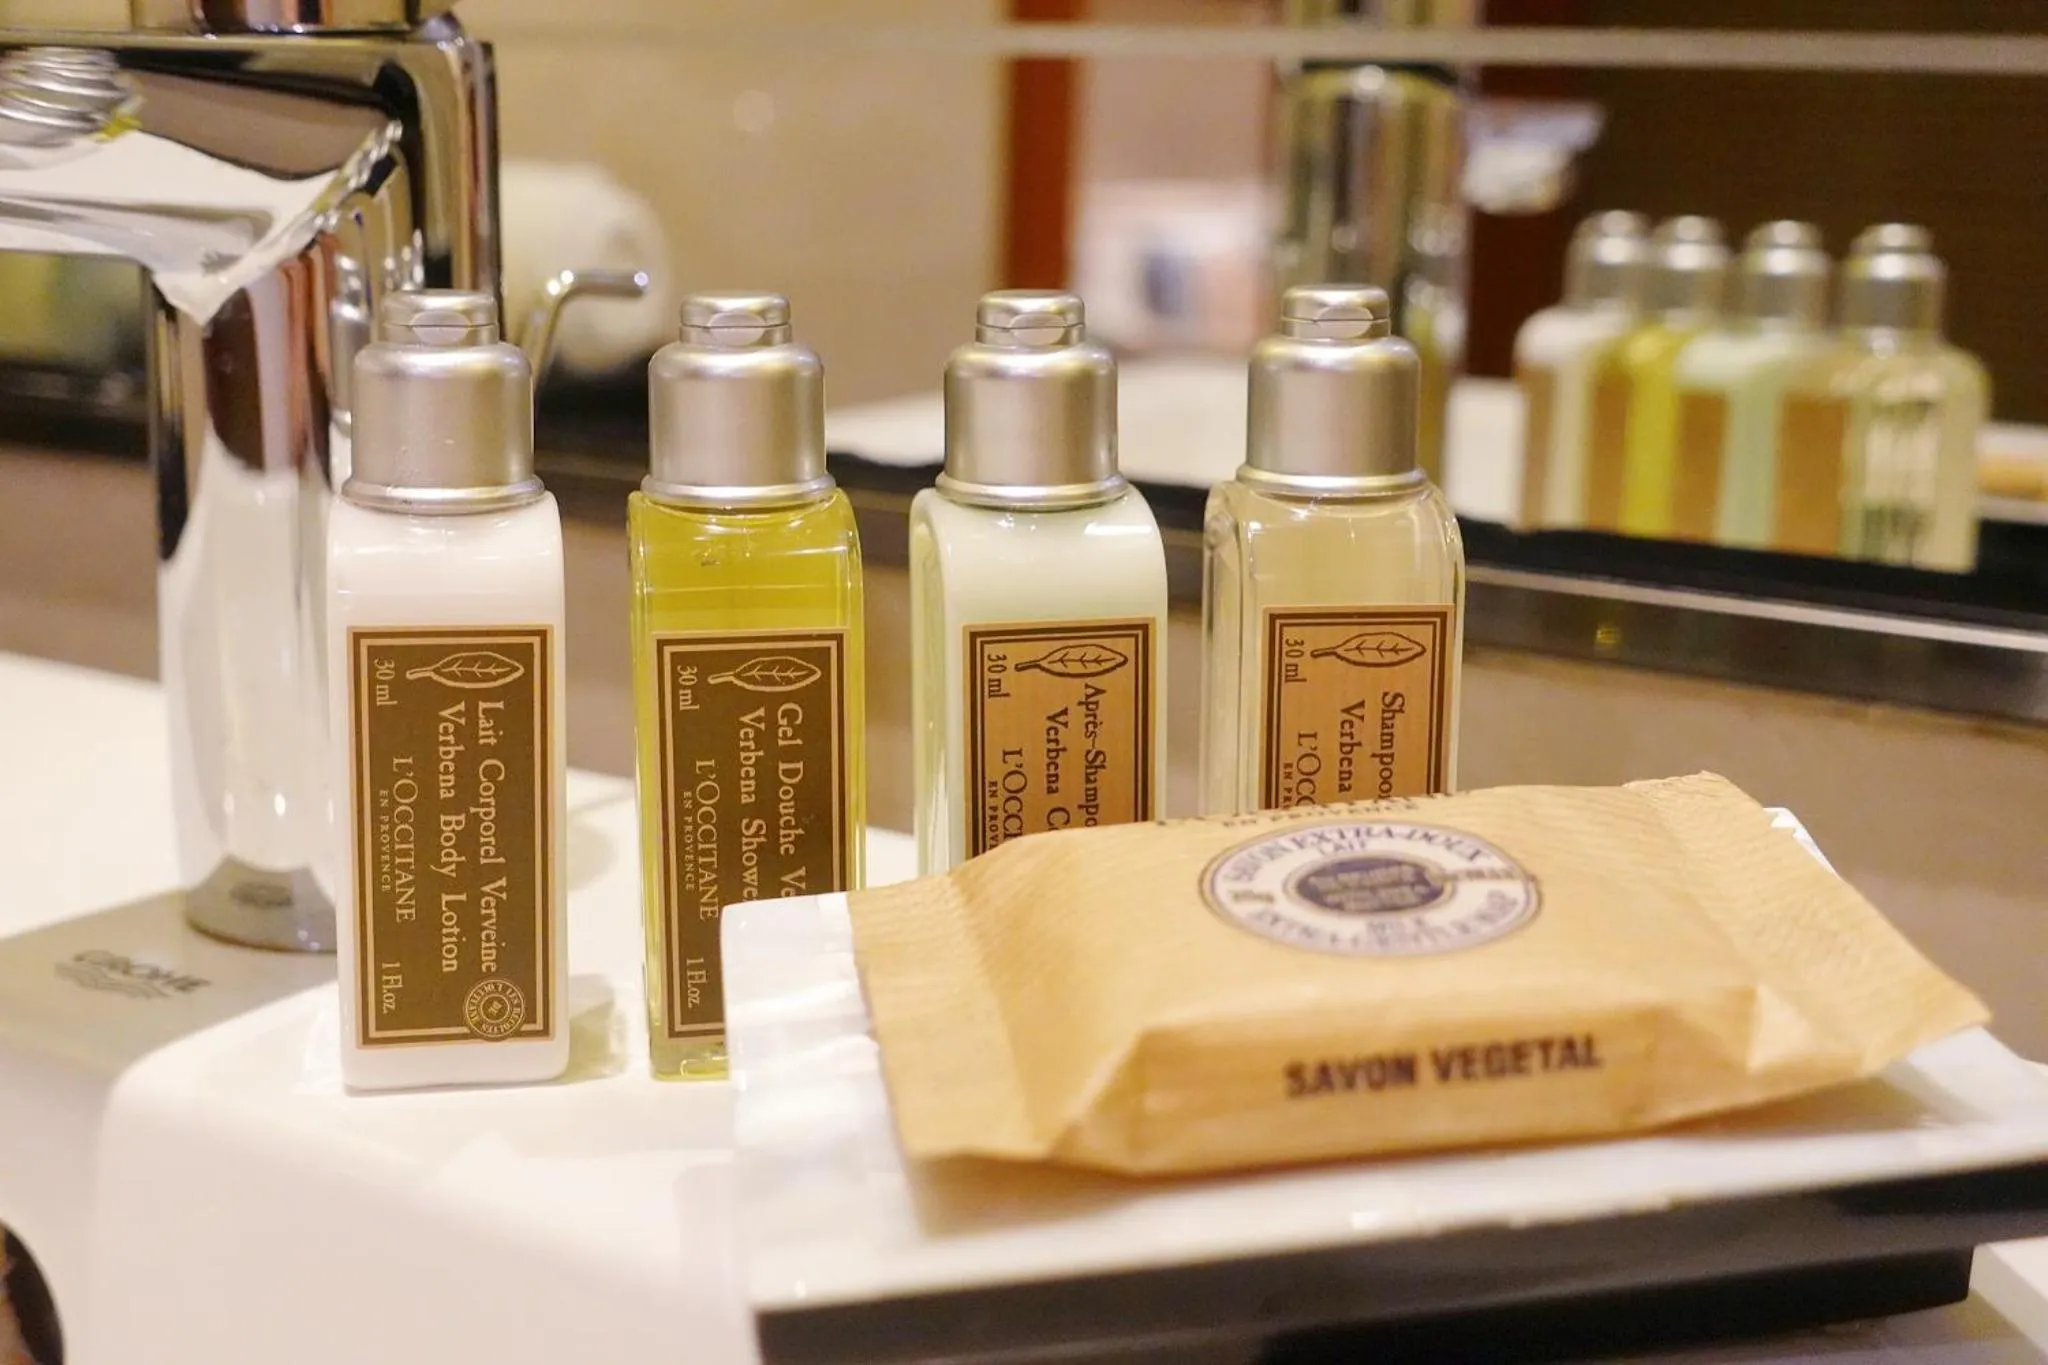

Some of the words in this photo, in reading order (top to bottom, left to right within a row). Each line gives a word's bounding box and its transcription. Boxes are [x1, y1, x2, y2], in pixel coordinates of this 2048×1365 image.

[374, 658, 395, 682] 30
[677, 665, 697, 687] 30
[987, 654, 1007, 673] 30
[1285, 639, 1304, 658] 30
[1285, 664, 1307, 683] ml
[376, 684, 398, 706] ml
[679, 690, 700, 711] ml
[988, 679, 1010, 699] ml
[437, 700, 466, 799] Verbena
[477, 701, 504, 746] Lait
[738, 707, 765, 804] Verbena
[777, 703, 803, 746] Gel
[1045, 707, 1069, 795] Verbena
[1338, 700, 1365, 793] Verbena
[379, 790, 389, 807] EN
[683, 791, 693, 808] EN
[988, 781, 998, 798] EN
[1283, 763, 1293, 780] EN
[392, 757, 418, 922] L'OCCITANE
[470, 758, 505, 864] Corporel
[695, 759, 720, 920] L'OCCITANE
[778, 761, 804, 855] Douche
[380, 814, 391, 893] PROVENCE
[430, 813, 466, 878] Body
[684, 814, 695, 891] PROVENCE
[740, 818, 767, 902] Showe
[441, 893, 467, 972] Lotion
[480, 877, 506, 973] Verveine
[1283, 1053, 1417, 1099] SAVON
[1430, 1032, 1604, 1083] VEGETAL
